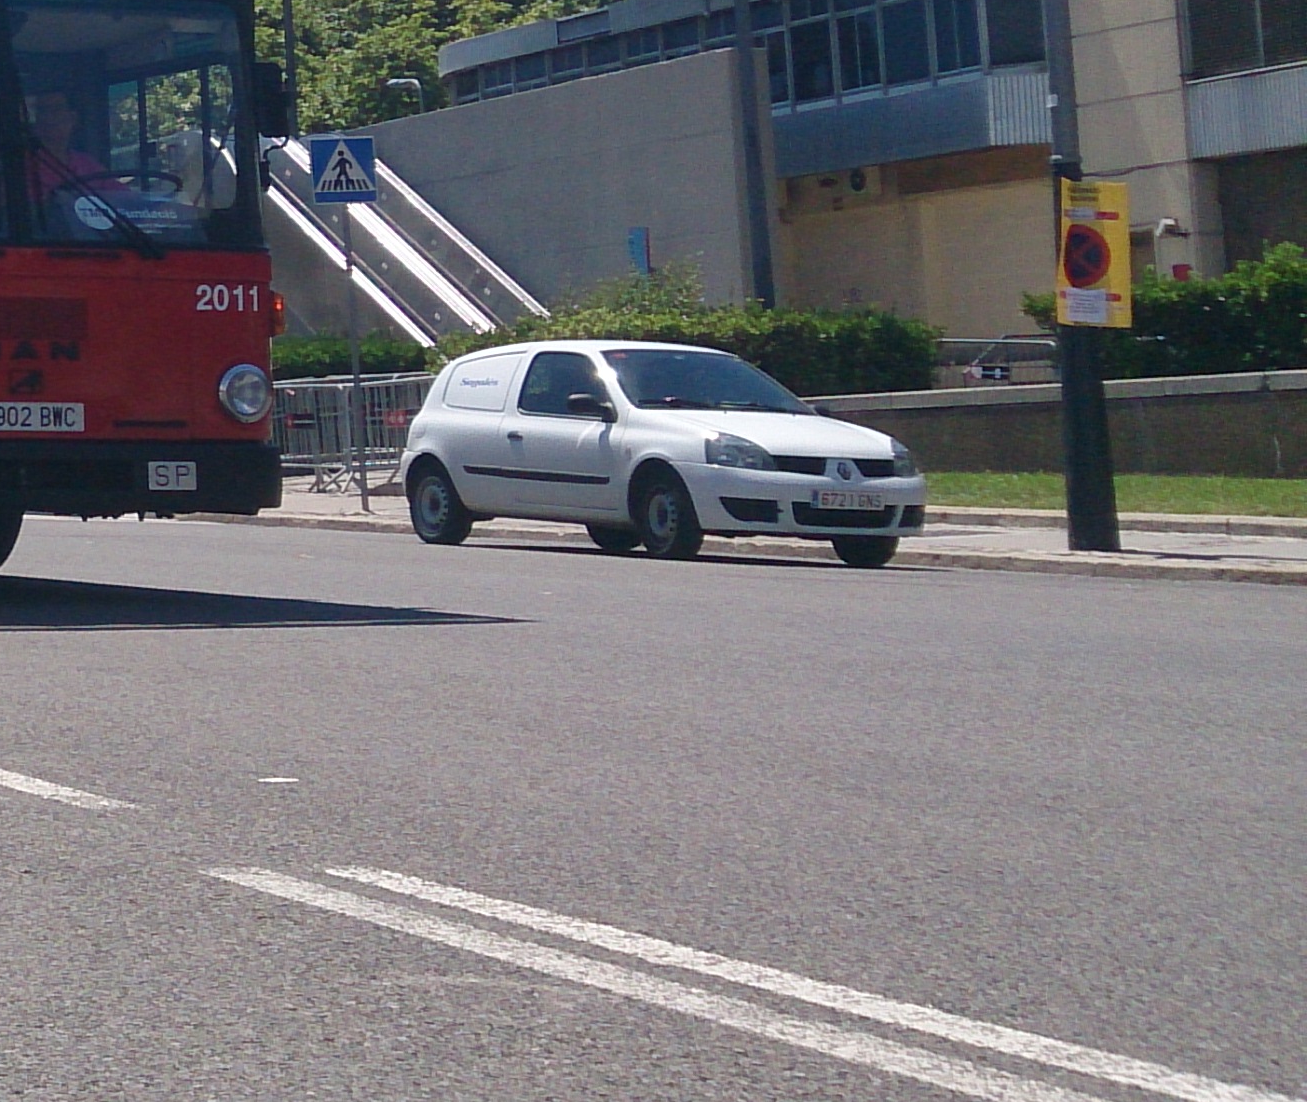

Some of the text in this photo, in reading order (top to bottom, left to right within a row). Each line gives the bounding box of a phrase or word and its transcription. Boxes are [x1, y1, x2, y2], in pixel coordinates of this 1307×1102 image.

[195, 284, 259, 312] 2011
[40, 406, 76, 427] BWC
[154, 464, 191, 487] SP
